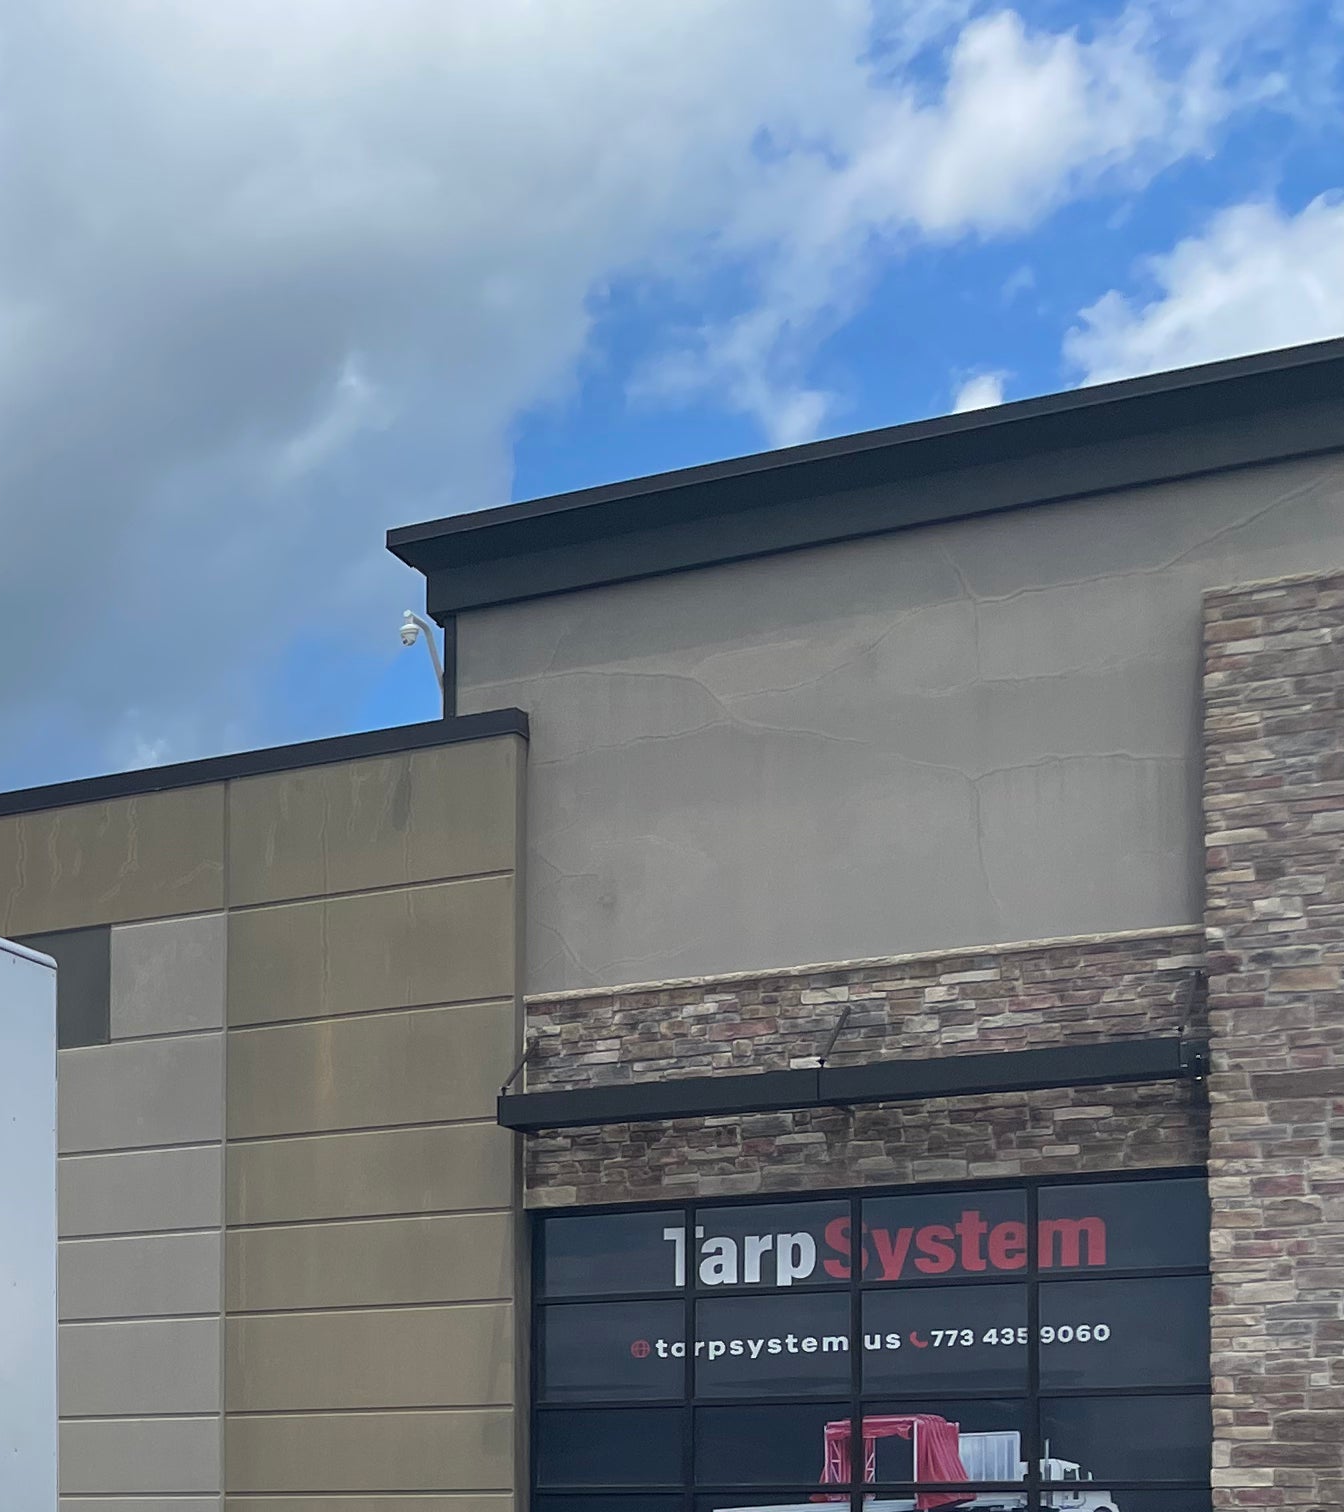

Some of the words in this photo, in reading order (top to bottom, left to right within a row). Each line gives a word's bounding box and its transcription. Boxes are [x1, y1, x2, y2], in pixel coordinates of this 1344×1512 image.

[655, 1332, 901, 1361] tarpsystemus
[930, 1329, 975, 1348] 773
[982, 1327, 1029, 1346] 435
[1040, 1323, 1111, 1345] 9060
